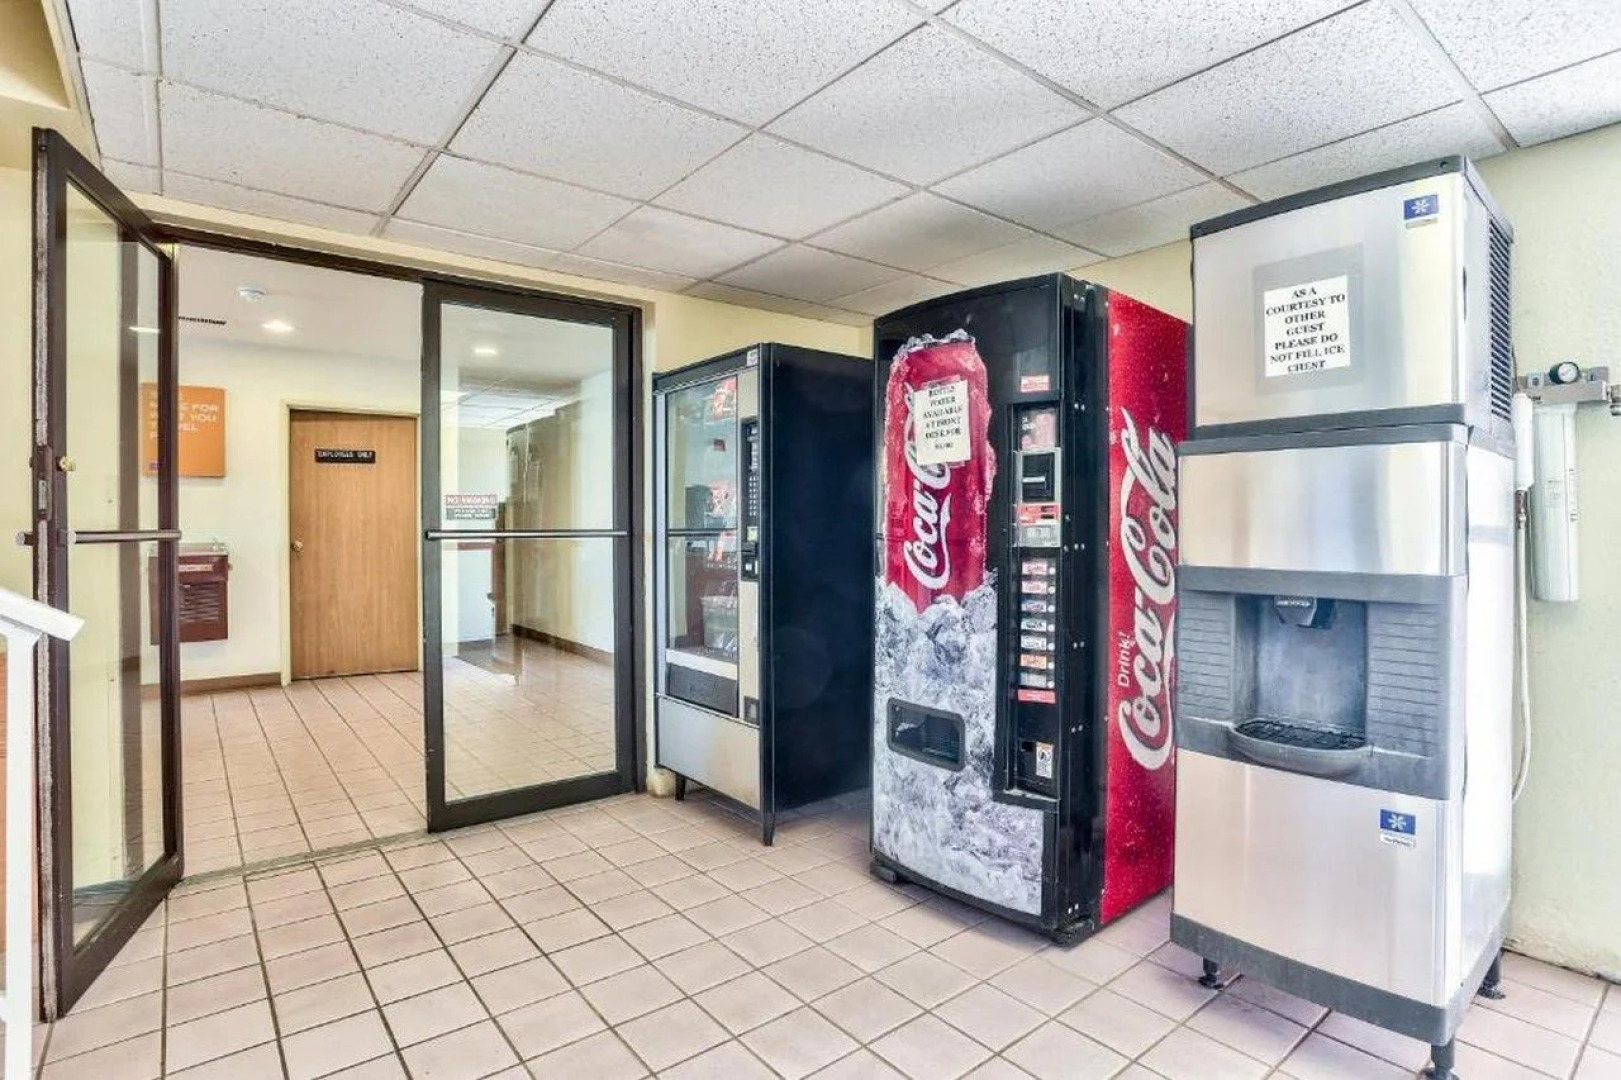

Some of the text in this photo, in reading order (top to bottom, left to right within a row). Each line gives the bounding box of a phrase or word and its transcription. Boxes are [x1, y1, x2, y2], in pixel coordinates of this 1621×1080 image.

[1292, 286, 1317, 299] AS A
[1266, 293, 1345, 316] COURTESY TO
[1284, 310, 1326, 324] OTHER
[1286, 322, 1325, 336] GUEST
[1275, 333, 1338, 350] PLEASE DO
[1270, 345, 1345, 364] NOT FILL ICE
[1288, 360, 1326, 372] CHEST
[923, 406, 962, 418] AVAILABLE
[936, 417, 961, 427] FRONT
[356, 451, 373, 459] ONLY
[1117, 631, 1136, 688] Drink!
